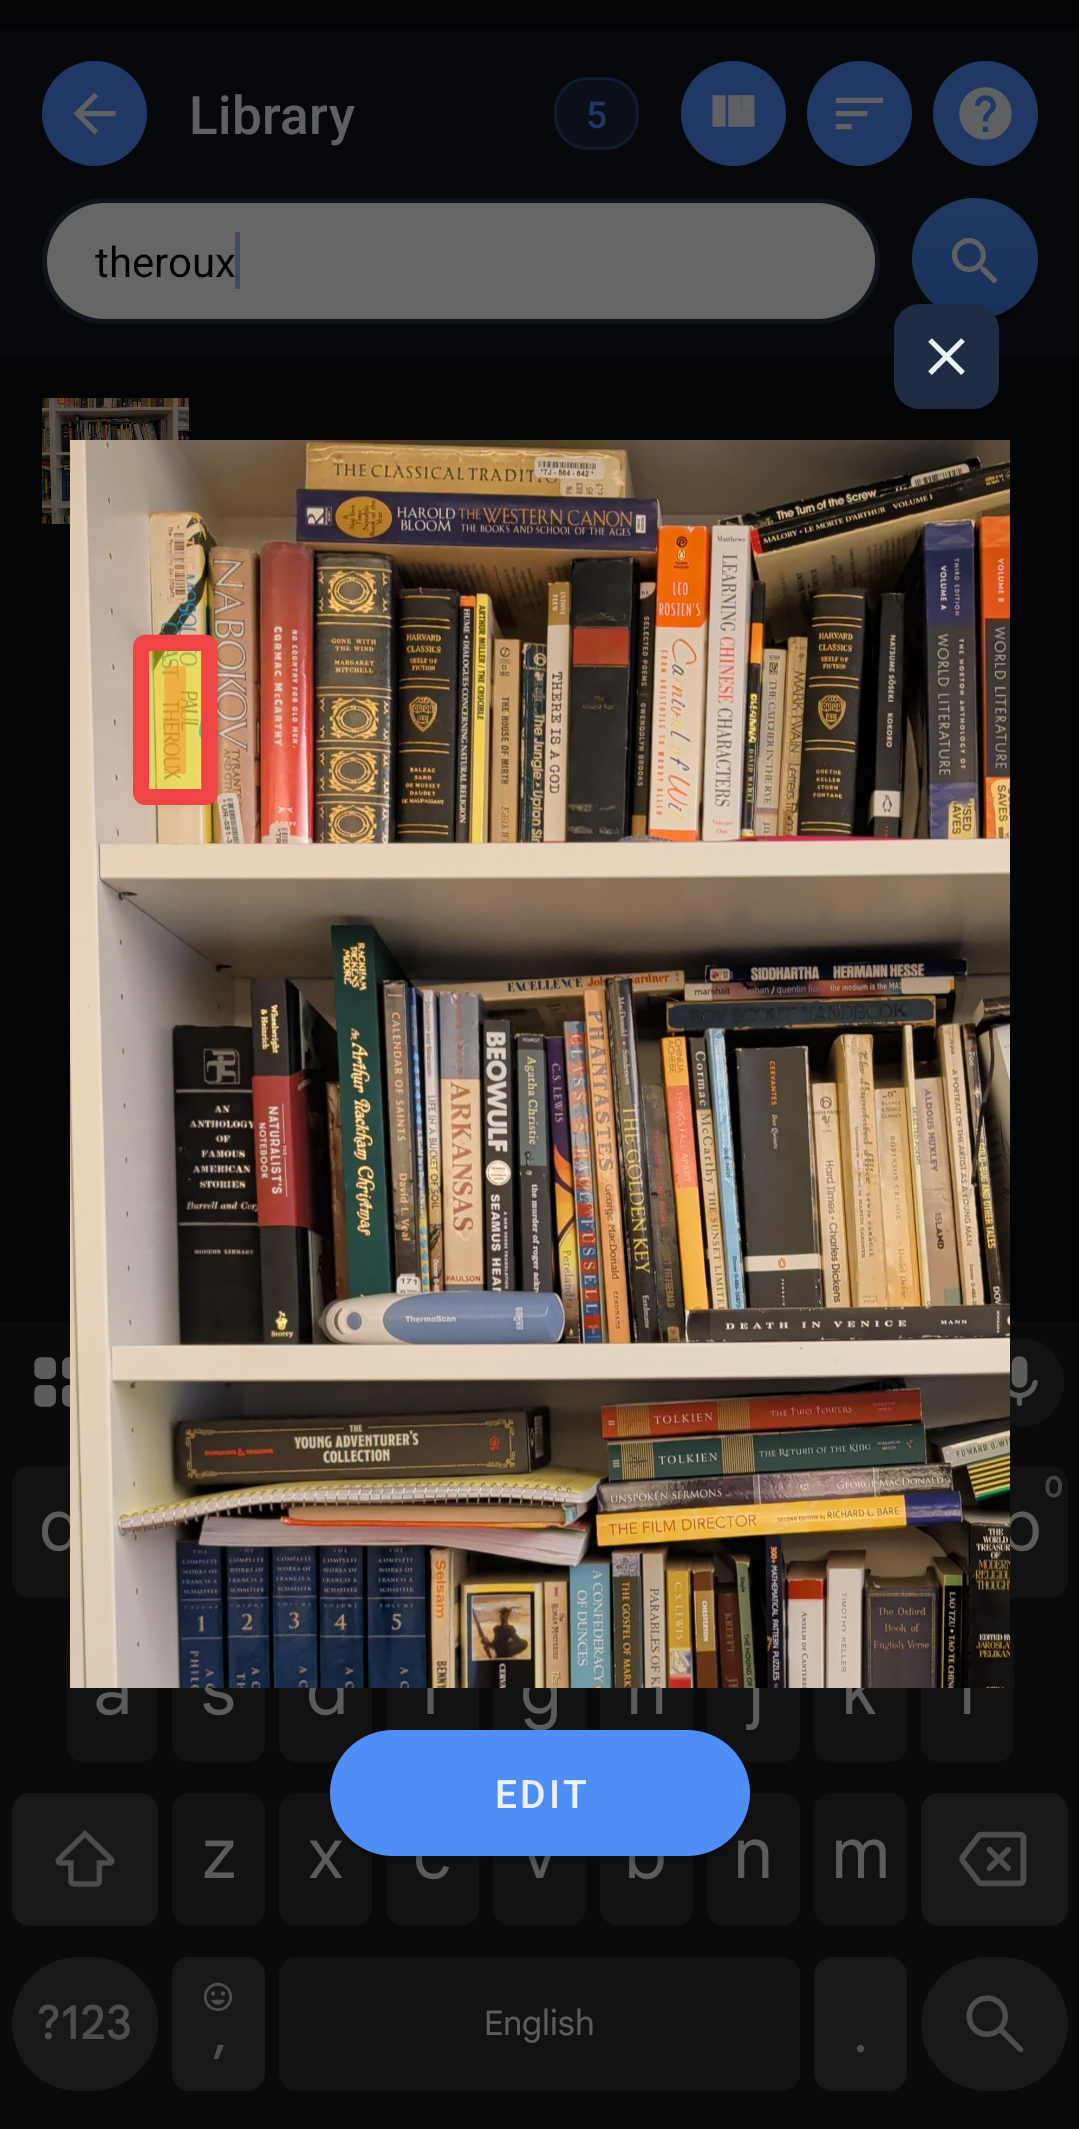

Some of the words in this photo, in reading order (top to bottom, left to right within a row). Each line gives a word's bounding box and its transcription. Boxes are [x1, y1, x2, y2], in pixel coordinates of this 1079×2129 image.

[190, 94, 355, 146] Library
[587, 101, 607, 130] 5
[95, 244, 236, 279] theroux
[333, 462, 367, 478] THE
[371, 464, 464, 481] CLASSICAL
[397, 506, 456, 520] HAROLD
[458, 508, 482, 521] THE
[483, 507, 565, 526] WESTERN
[567, 510, 633, 527] CANON
[776, 509, 794, 521] The
[795, 504, 815, 516] Turn
[816, 500, 827, 511] of
[827, 497, 845, 509] the
[846, 489, 877, 504] Screw
[401, 519, 452, 532] BLOOM
[717, 535, 746, 543] Matthews
[672, 581, 689, 596] LEO
[719, 554, 738, 632] LEARNING
[939, 565, 948, 602] VOLUME
[463, 608, 471, 635] HUME
[659, 602, 701, 617] ROSTEN'S
[406, 633, 442, 643] HARVARD
[406, 645, 442, 655] CLASSICS
[818, 632, 853, 641] HARVARD
[818, 644, 853, 653] CLASSICS
[213, 558, 248, 751] NABOKOV
[273, 626, 283, 678] CORMAC
[334, 659, 375, 667] MARGARET
[461, 640, 470, 687] DIALOGUES
[937, 633, 951, 687] WORLD
[994, 626, 1007, 680] WORLD
[335, 667, 374, 675] MITCHELL
[412, 664, 436, 672] FICTION
[717, 636, 736, 704] CHINESE
[179, 690, 198, 731] PAUL
[550, 672, 563, 725] THERE
[274, 681, 283, 748] McCARTHY
[460, 688, 470, 744] CONCERNING
[534, 714, 545, 736] The
[993, 685, 1008, 770] LITERATURE
[162, 699, 182, 781] THEROUX
[550, 728, 562, 746] IS
[937, 693, 952, 776] LITERATURE
[459, 745, 468, 784] NATURAL
[529, 738, 544, 780] Jungle
[550, 751, 561, 766] A
[714, 708, 734, 808] CHARACTERS
[815, 768, 842, 776] GOETHE
[549, 771, 561, 795] GOD
[812, 792, 843, 800] FONTANE
[458, 784, 467, 824] RELIGION
[529, 790, 544, 826] Upton
[997, 784, 1008, 822] SAVES
[507, 978, 583, 993] EXCELLENCE
[750, 966, 819, 981] SIDDHARTHA
[833, 964, 888, 979] HERMANN
[889, 963, 925, 977] HESSE
[694, 986, 731, 996] marshall
[390, 1012, 404, 1075] CALENDAR
[524, 1056, 539, 1097] Agatha
[552, 1063, 563, 1082] C.S.
[570, 1033, 586, 1100] CLASS
[695, 1050, 709, 1107] Cormac
[394, 1079, 405, 1095] OF
[485, 1031, 508, 1153] BEOWULF
[587, 1009, 614, 1173] PHANTASTES
[769, 1060, 778, 1106] CERVANTES
[214, 1105, 230, 1114] AN
[553, 1086, 565, 1123] LEWIS
[924, 1088, 935, 1130] ALDOUS
[189, 1119, 255, 1129] ANTHOLOGY
[396, 1099, 407, 1142] SAINTS
[527, 1099, 540, 1145] Christie
[622, 1104, 639, 1142] THE
[201, 1149, 246, 1159] FAMOUS
[259, 1122, 269, 1179] NOTEBOOK
[268, 1105, 282, 1195] NATURALIST'S
[450, 1081, 474, 1232] ARKANSAS
[697, 1113, 715, 1185] McCarthy
[889, 1135, 899, 1181] ROBINSON
[928, 1132, 939, 1172] HUXLEY
[193, 1164, 251, 1174] AMERICAN
[199, 1179, 246, 1189] STORIES
[824, 1159, 836, 1184] Hard
[625, 1147, 647, 1232] GOLDEN
[708, 1190, 717, 1214] THE
[826, 1186, 836, 1214] Times
[893, 1185, 902, 1220] CRUSOE
[490, 1193, 502, 1252] SEAMUS
[934, 1212, 945, 1250] ISLAND
[710, 1217, 722, 1262] SUNSET
[829, 1222, 840, 1262] Charles
[633, 1237, 651, 1274] KEY
[446, 1274, 481, 1283] PAULSON
[831, 1264, 842, 1303] Dickens
[405, 1315, 457, 1324] ThermoScan
[725, 1321, 789, 1330] DEATH
[802, 1320, 821, 1330] IN
[834, 1319, 908, 1329] VENICE
[940, 1318, 968, 1326] MANN
[348, 1424, 363, 1433] THE
[653, 1411, 714, 1426] TOLKIEN
[294, 1435, 333, 1450] YOUNG
[335, 1430, 420, 1448] ADVENTURER'S
[956, 1445, 987, 1458] EDWARD
[322, 1448, 391, 1463] COLLECTION
[658, 1452, 718, 1466] TOLKIEN
[610, 1489, 669, 1505] UNSPOKEN
[671, 1487, 723, 1502] SERMONS
[836, 1478, 876, 1491] GEORGE
[608, 1522, 638, 1536] THE
[641, 1519, 676, 1534] FILM
[680, 1514, 757, 1532] DIRECTOR
[982, 1535, 1009, 1544] WORLD
[987, 1528, 1004, 1536] THE
[770, 1546, 778, 1564] 300+
[990, 1551, 1001, 1560] OF
[434, 1559, 448, 1619] Selsam
[592, 1569, 602, 1579] A
[576, 1589, 588, 1607] OF
[770, 1564, 779, 1617] MATHEMATICAL
[197, 1615, 205, 1633] 1
[241, 1613, 254, 1631] 2
[288, 1612, 300, 1630] 3
[334, 1614, 348, 1631] 4
[391, 1613, 402, 1631] 5
[649, 1588, 660, 1653] PARABLES
[701, 1600, 709, 1642] CHESTERTON
[840, 1592, 848, 1633] TIMOTHY
[877, 1606, 894, 1616] The
[897, 1606, 926, 1616] Oxford
[577, 1611, 588, 1667] DUNCES
[592, 1582, 605, 1683] CONFEDERACY
[771, 1619, 780, 1649] PATTERN
[884, 1623, 907, 1633] Book
[910, 1622, 920, 1632] of
[873, 1639, 904, 1652] English
[907, 1640, 929, 1650] Verse
[650, 1655, 660, 1673] OF
[772, 1651, 781, 1681] PUZZLES
[496, 1779, 588, 1810] EDIT
[205, 1839, 235, 1879] z
[309, 1839, 343, 1879] x
[738, 1837, 770, 1879] n
[835, 1837, 889, 1879] m
[39, 2004, 132, 2041] ?123
[485, 2008, 595, 2044] English
